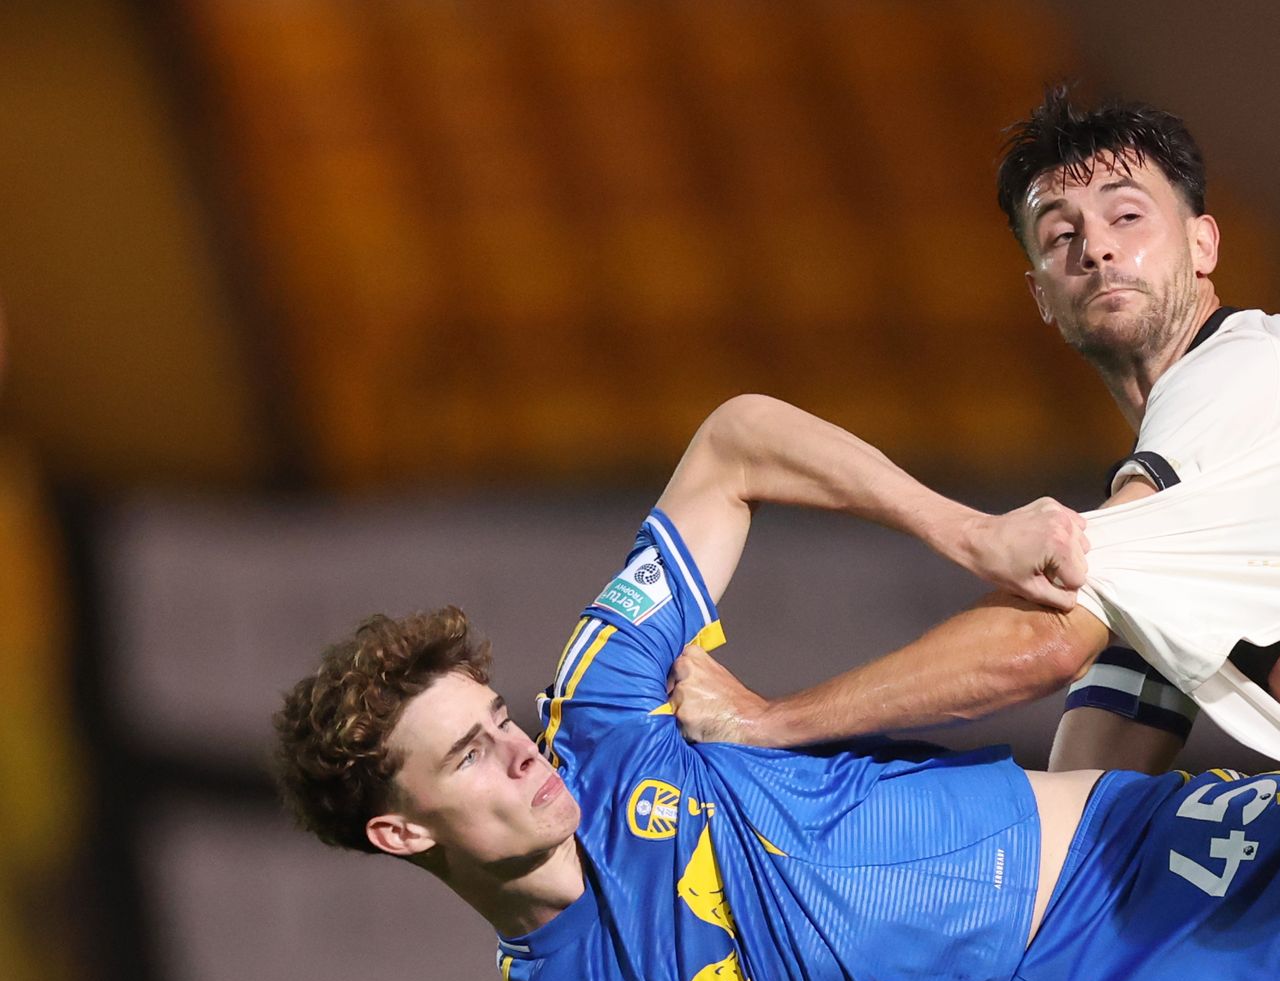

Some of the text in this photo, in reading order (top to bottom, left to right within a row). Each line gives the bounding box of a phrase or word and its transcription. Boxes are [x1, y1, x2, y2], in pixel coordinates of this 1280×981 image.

[606, 589, 641, 617] Vertu
[616, 583, 643, 602] TROPHY
[1169, 778, 1278, 897] 45
